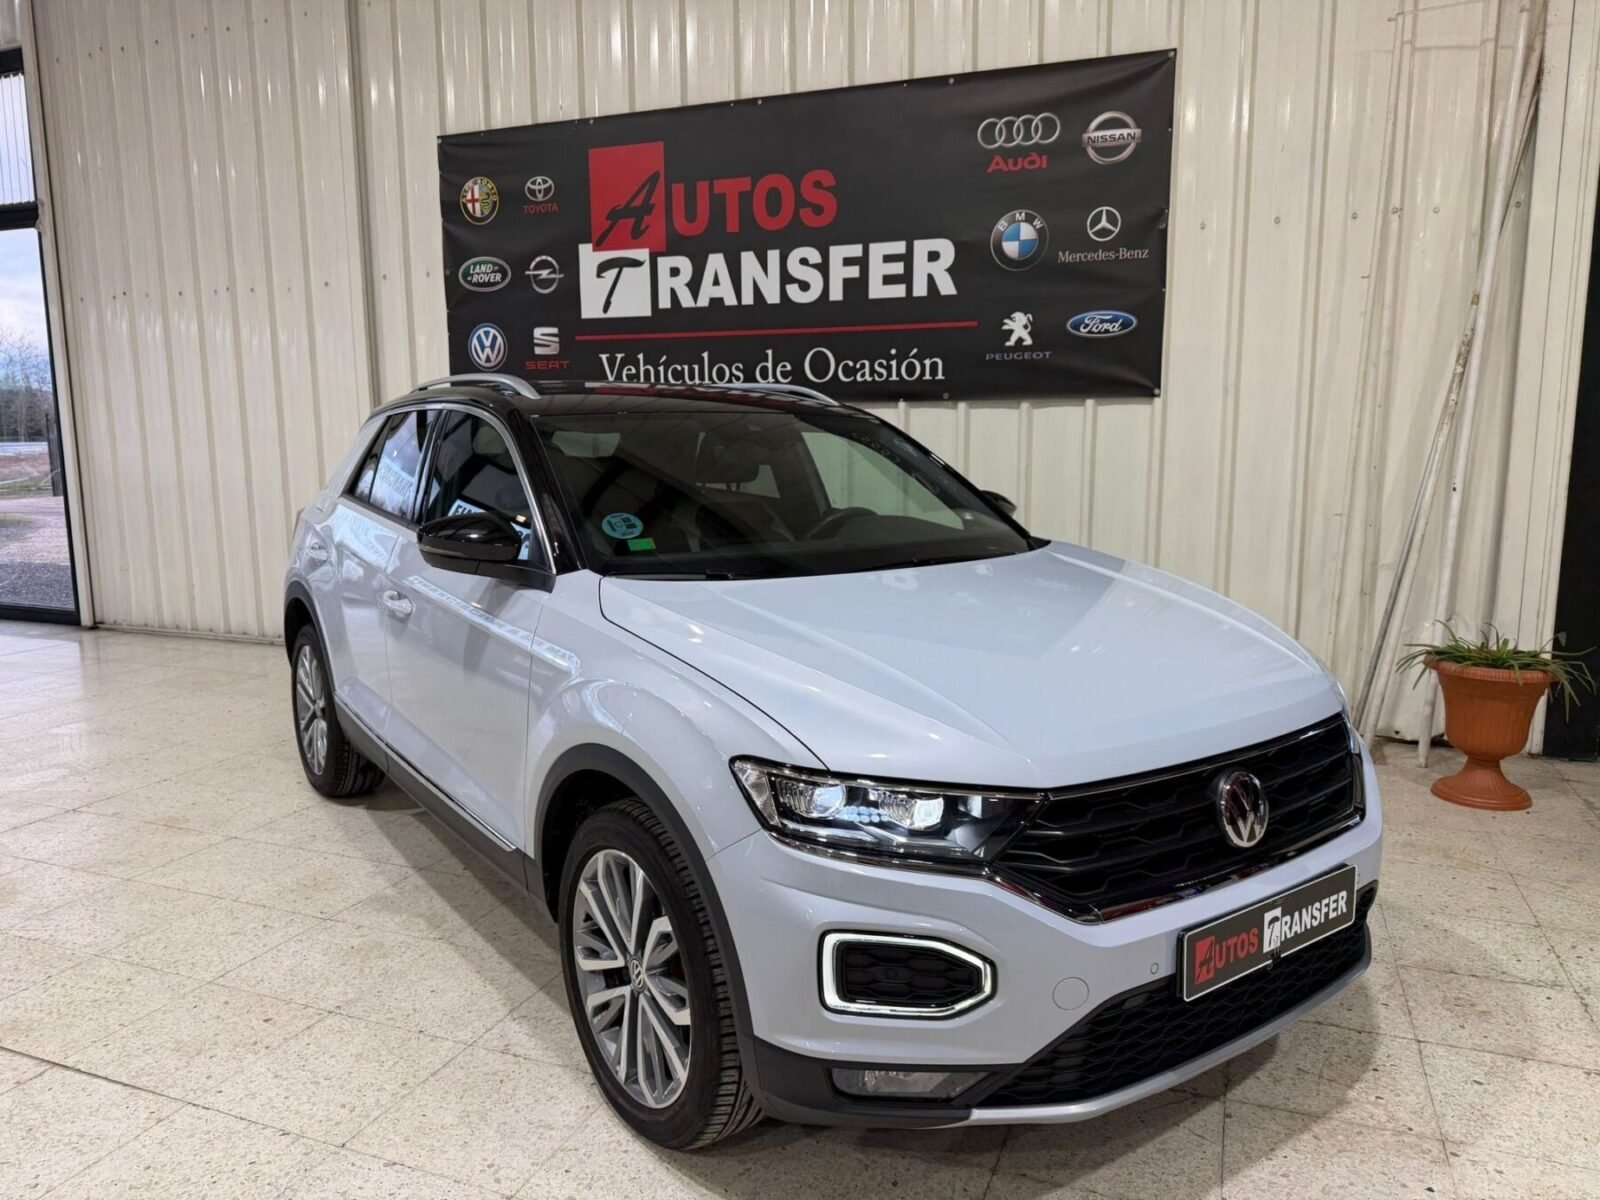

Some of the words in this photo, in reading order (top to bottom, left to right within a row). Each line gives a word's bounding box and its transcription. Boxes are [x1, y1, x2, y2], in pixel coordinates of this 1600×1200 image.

[1087, 131, 1137, 144] NISSAN
[986, 153, 1048, 173] Audi
[522, 203, 559, 214] TOYOTA
[597, 170, 837, 248] AUTOS
[1057, 247, 1149, 263] Mercedes-Benz
[469, 263, 493, 274] LAND
[596, 238, 958, 315] TRANSFER
[471, 273, 502, 284] ROVER
[1079, 311, 1122, 334] Ford
[985, 351, 1052, 361] PEUGEOT
[525, 360, 570, 370] SEAT
[599, 351, 744, 384] Vehículos
[755, 348, 792, 384] de
[804, 347, 945, 383] Ocasión
[1195, 928, 1259, 983] AUTOS
[1266, 890, 1348, 945] TRANSFER
